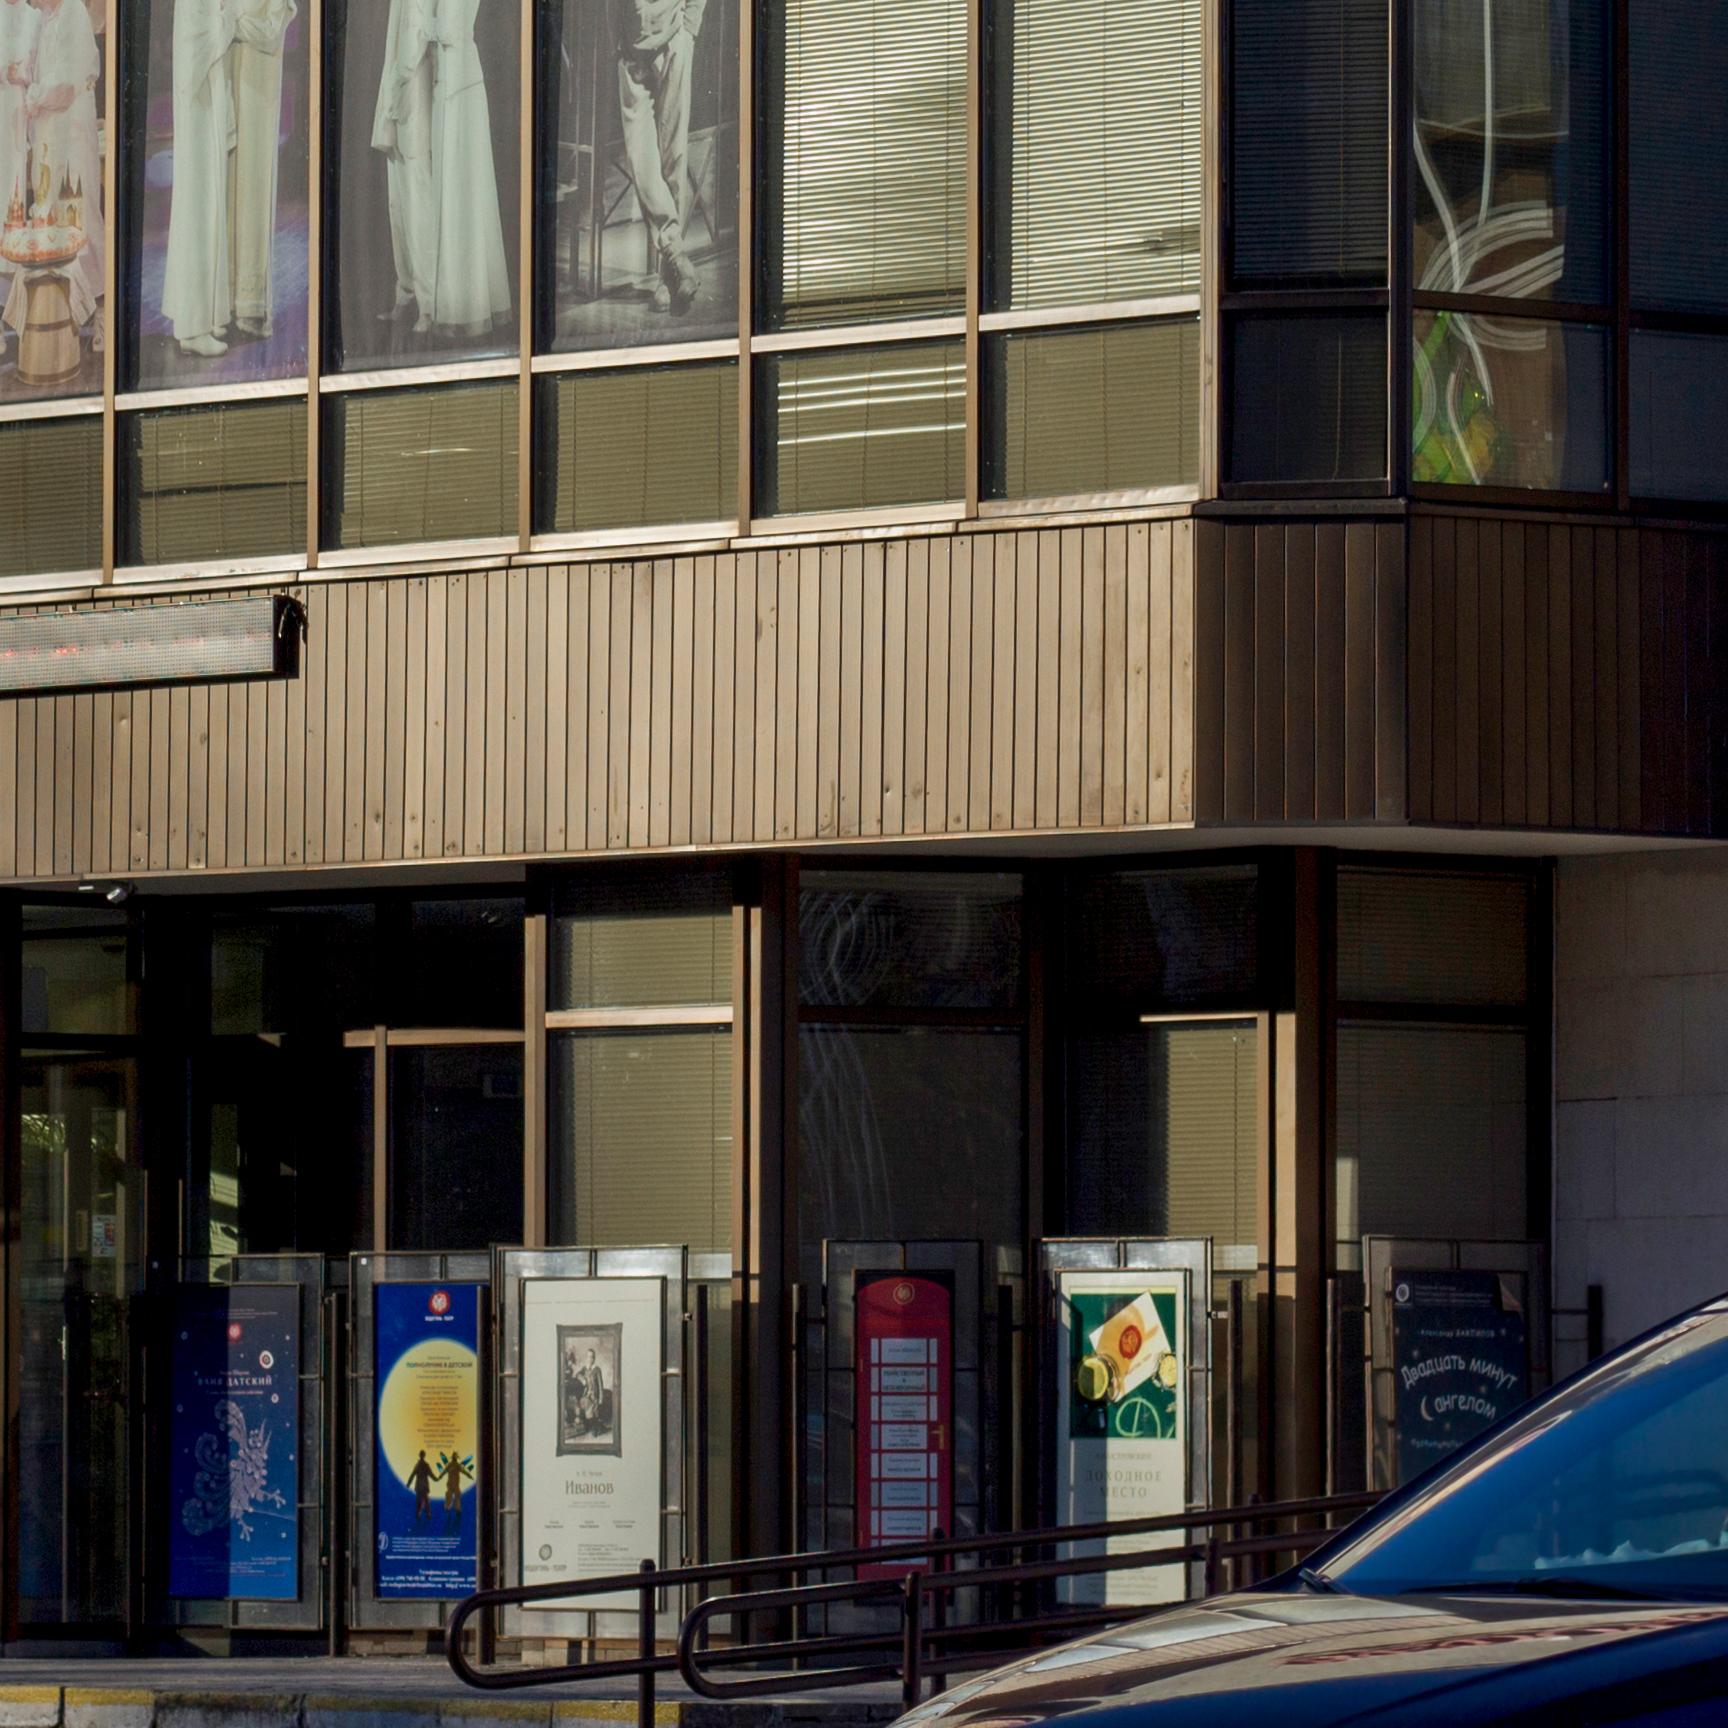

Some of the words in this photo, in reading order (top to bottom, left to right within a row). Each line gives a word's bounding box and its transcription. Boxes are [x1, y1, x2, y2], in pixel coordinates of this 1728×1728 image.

[1400, 1354, 1466, 1390] Двадцать
[1469, 1357, 1518, 1389] минут
[228, 1374, 272, 1387] ДАТСКИЙ
[1434, 1394, 1497, 1420] ангелом
[1085, 1470, 1162, 1483] ДОХОДНОЕ
[565, 1480, 614, 1495] Иванов
[1100, 1486, 1148, 1499] МЕСТО
